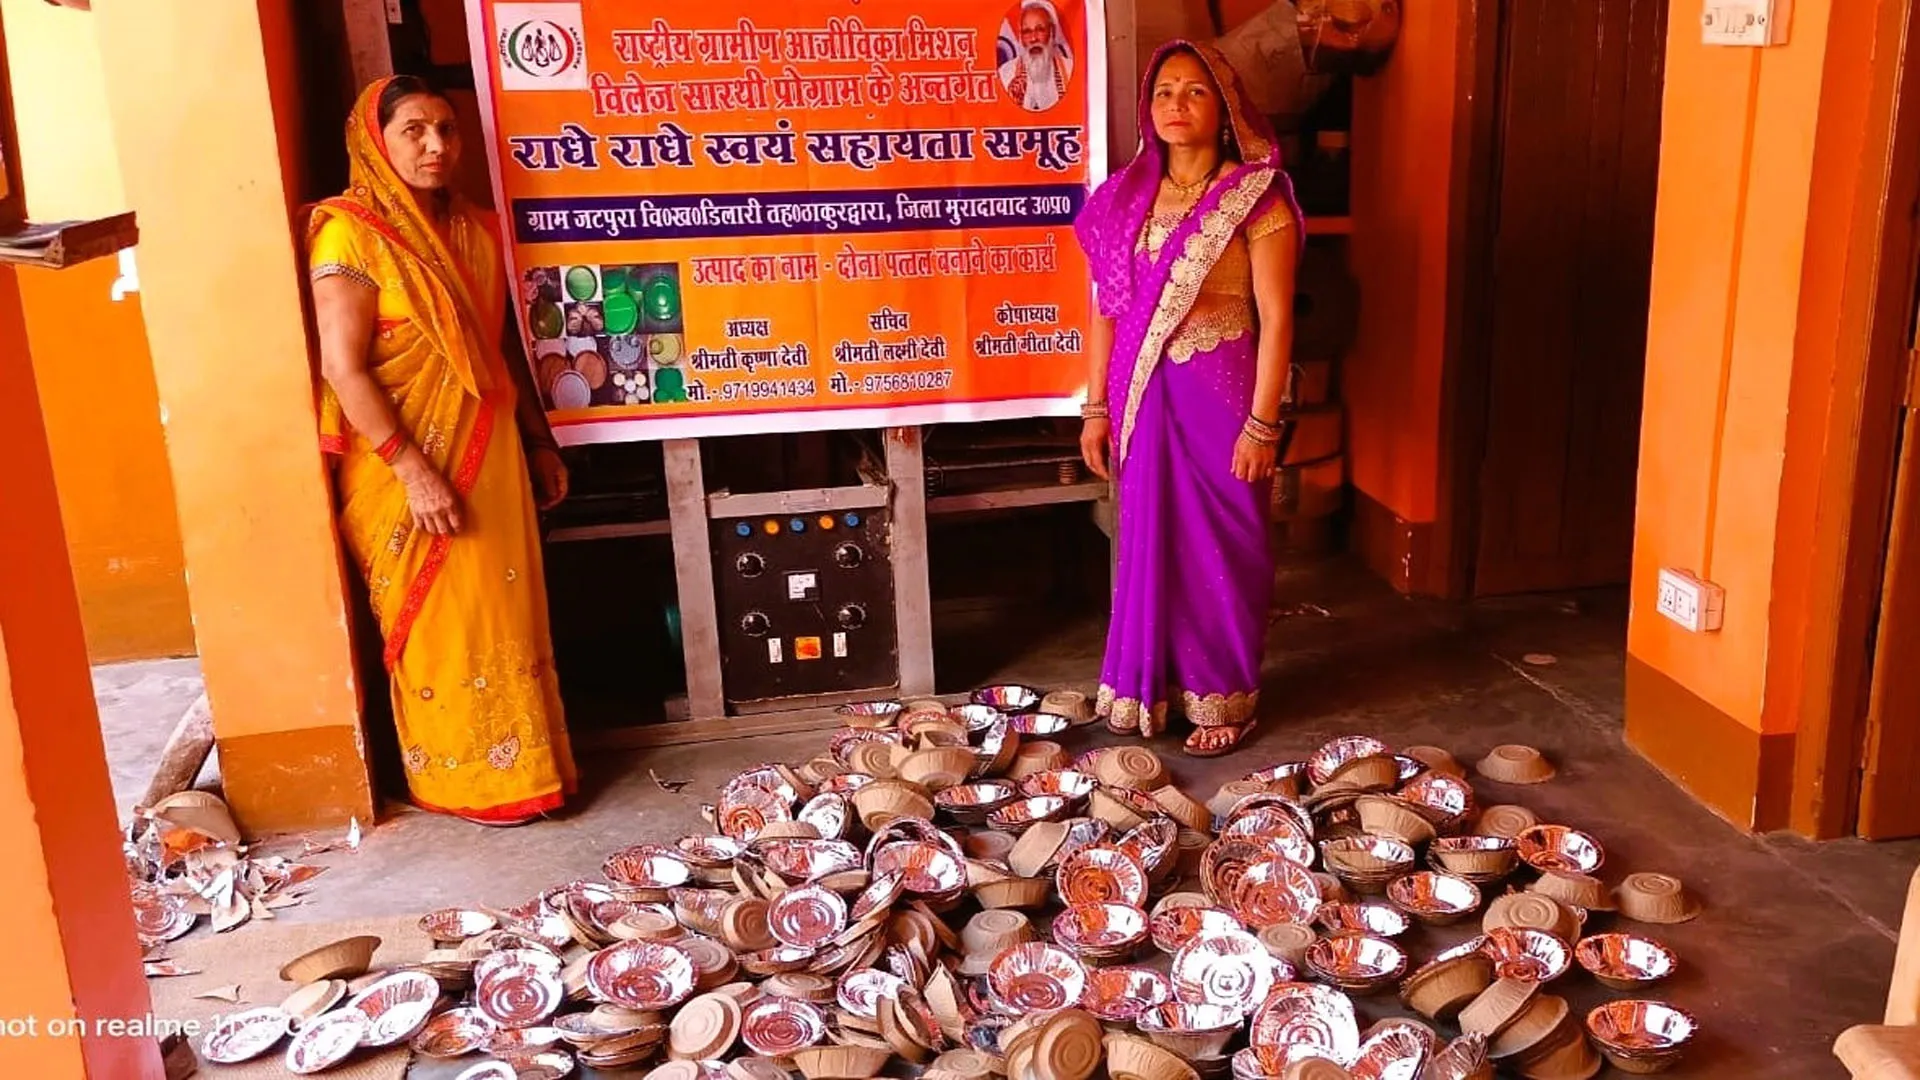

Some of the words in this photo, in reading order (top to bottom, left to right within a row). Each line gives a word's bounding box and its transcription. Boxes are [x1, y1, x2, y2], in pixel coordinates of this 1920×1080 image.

[613, 21, 692, 68] राष्ट्रीय
[697, 20, 780, 64] ग्रामीण
[785, 17, 903, 62] आजीविका
[908, 18, 977, 61] मिशन
[590, 73, 677, 115] विलेज
[680, 69, 768, 111] सारथी
[771, 66, 862, 109] प्रोग्राम
[867, 62, 892, 104] के
[900, 61, 998, 103] अन्तर्गत
[509, 123, 598, 168] राधे
[608, 122, 694, 168] राधे
[702, 118, 796, 166] स्वयं
[805, 129, 975, 170] सहायता
[983, 127, 1082, 171] समूह
[527, 209, 569, 232] ग्राम
[573, 208, 637, 236] जटपुरा
[896, 193, 941, 220] जिला
[692, 256, 746, 284] उत्पाद
[750, 256, 775, 282] का
[780, 254, 818, 281] नाम
[838, 244, 880, 279] दोना
[885, 251, 932, 277] पत्तल
[989, 247, 1014, 272] का
[1017, 235, 1056, 271] कार्य
[726, 320, 769, 337] अध्यक्ष
[869, 308, 908, 330] सचिव
[691, 347, 738, 371] श्रीमती
[741, 350, 777, 373] कृष्णा
[780, 344, 808, 366] देवी
[834, 339, 879, 363] श्रीमती
[882, 337, 918, 360] लक्ष्मी
[920, 335, 946, 359] देवी
[974, 332, 1017, 357] श्रीमती
[1018, 331, 1051, 354] गीता
[1054, 330, 1080, 353] देवी
